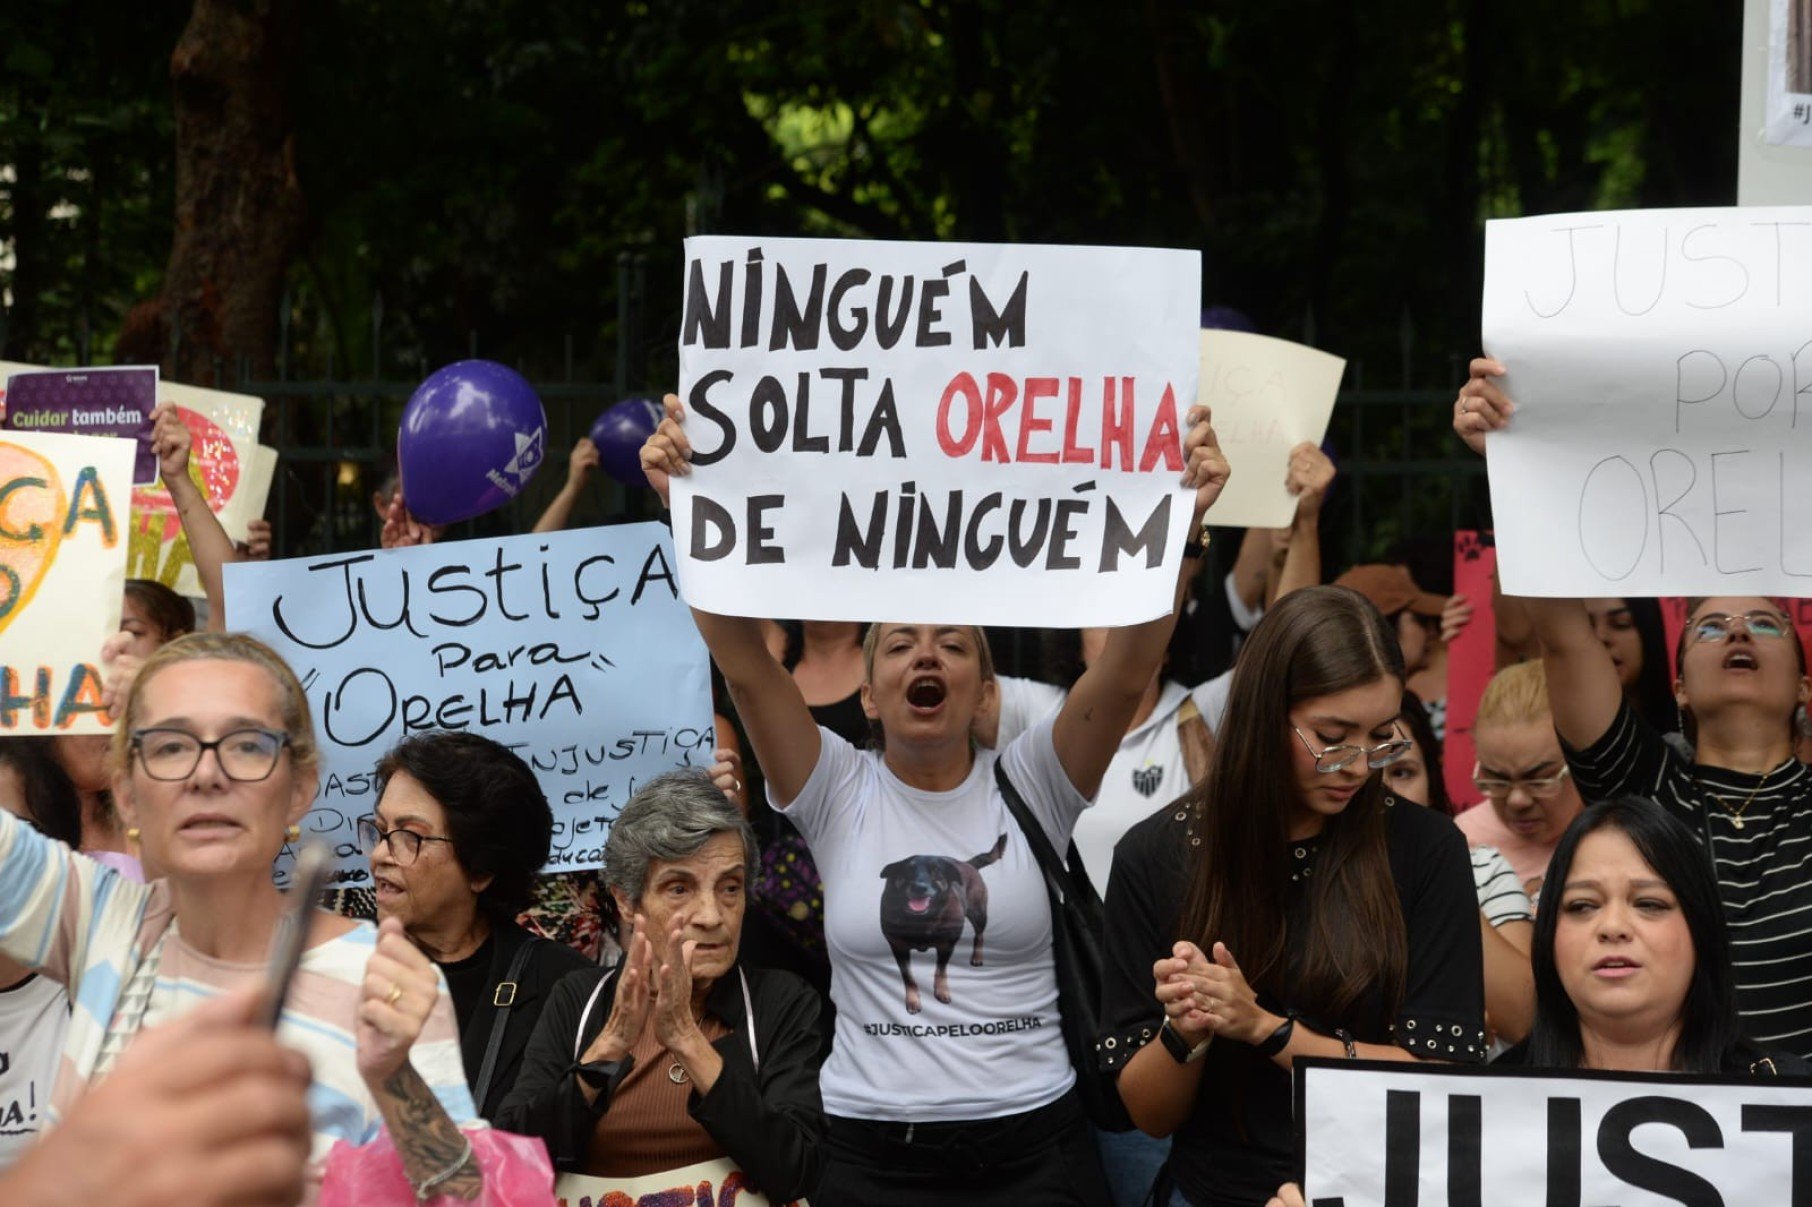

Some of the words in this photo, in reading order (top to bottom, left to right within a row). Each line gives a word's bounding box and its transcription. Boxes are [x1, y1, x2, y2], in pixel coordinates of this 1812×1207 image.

[1524, 221, 1812, 318] JUST
[13, 410, 68, 427] Cuidar
[72, 404, 142, 426] também
[688, 367, 907, 467] SOLTA
[935, 371, 1186, 473] ORELHA
[689, 494, 785, 565] DE
[863, 1016, 1042, 1038] #JUSTICAPELOORELHA
